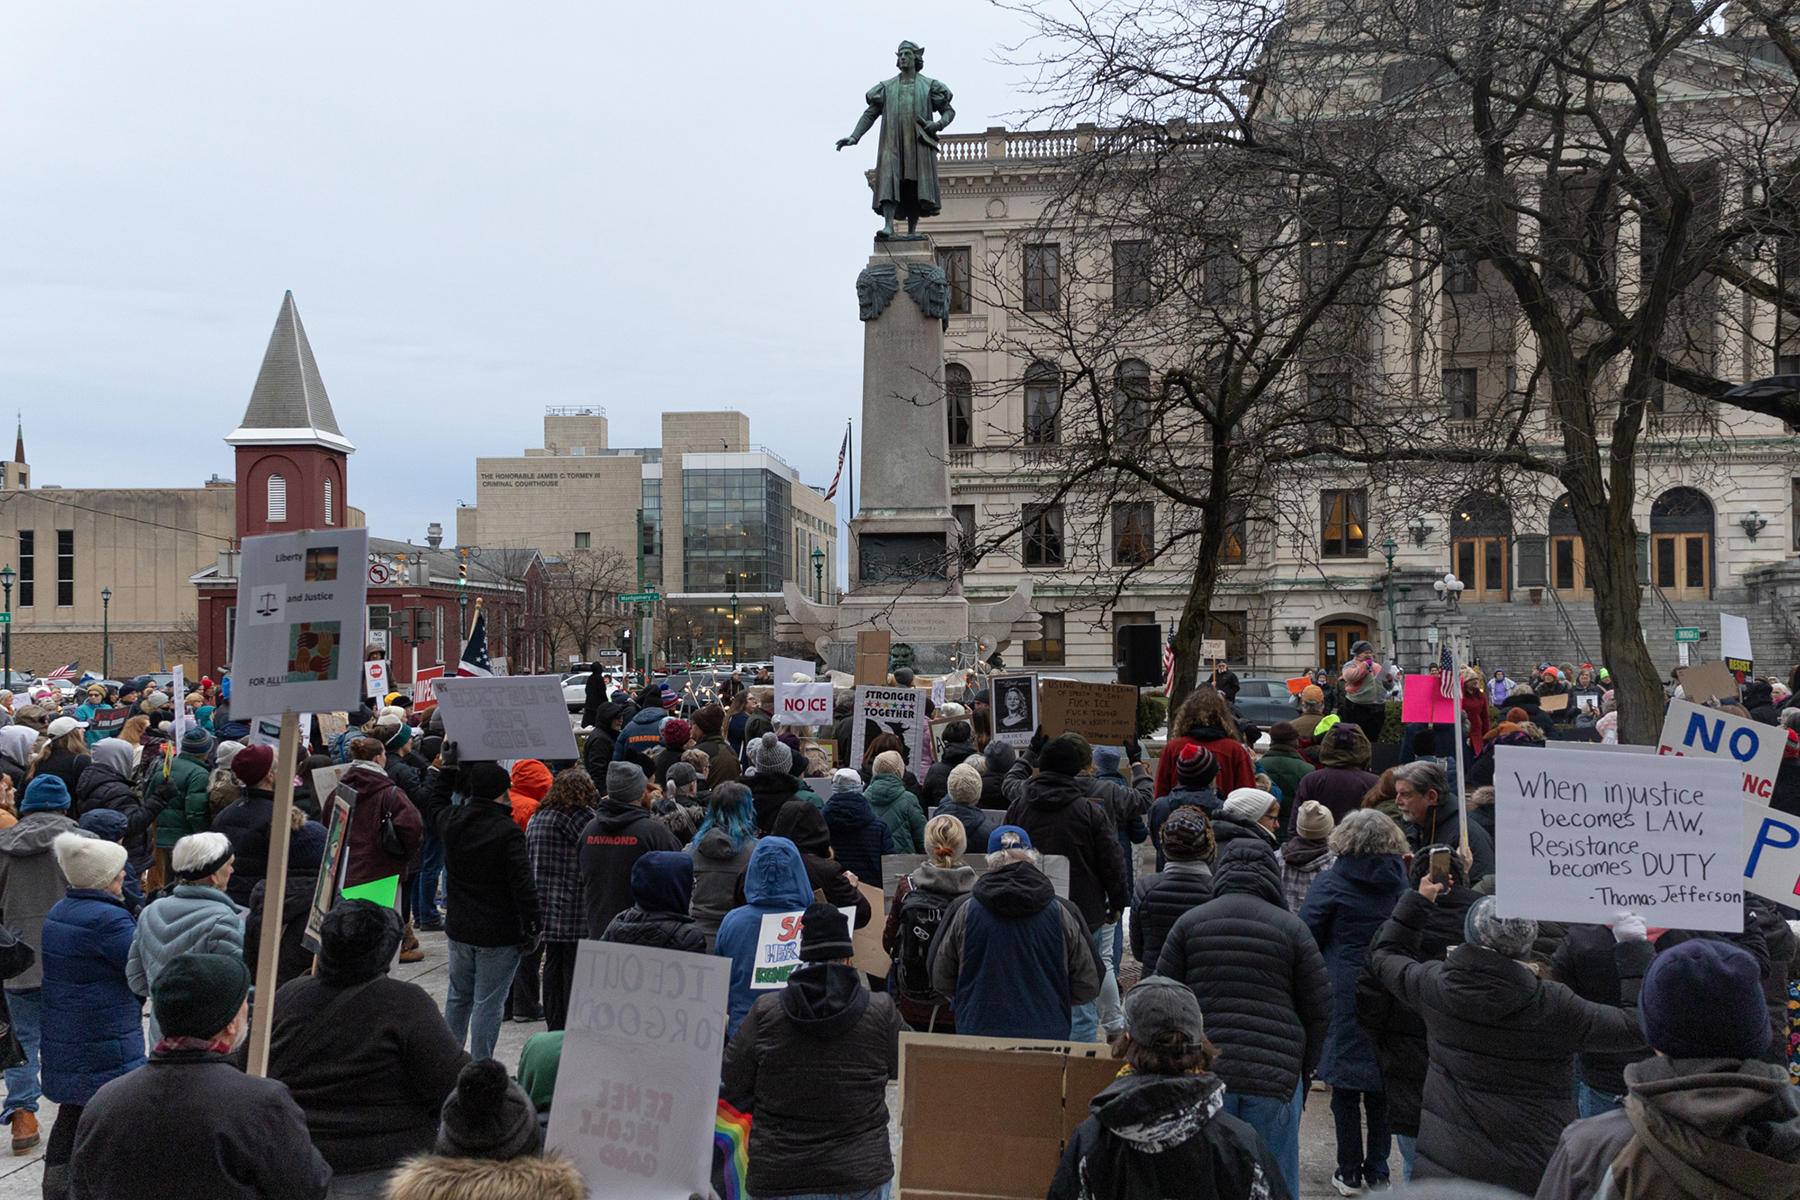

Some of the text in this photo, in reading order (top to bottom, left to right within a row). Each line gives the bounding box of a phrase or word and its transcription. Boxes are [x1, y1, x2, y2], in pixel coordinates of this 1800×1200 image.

[275, 553, 303, 562] Liberty
[286, 592, 334, 602] and Justice
[249, 678, 265, 686] FOR
[1048, 680, 1075, 689] USING
[1097, 684, 1134, 693] FREEDOM
[865, 690, 916, 702] STRONGER
[784, 698, 826, 711] NO ICE
[1068, 698, 1110, 708] FUCK ICE
[864, 708, 914, 718] TOGETHER
[629, 735, 660, 743] SYRACUSE
[1683, 712, 1759, 762] NO
[1514, 771, 1704, 815] When injustice
[1541, 808, 1703, 836] becomes LAW,
[587, 836, 638, 845] RAYMOND
[1529, 831, 1639, 858] Resistance
[1550, 852, 1716, 880] becomes DUTY
[1658, 885, 1742, 904] Jefferson
[764, 942, 800, 964] HER
